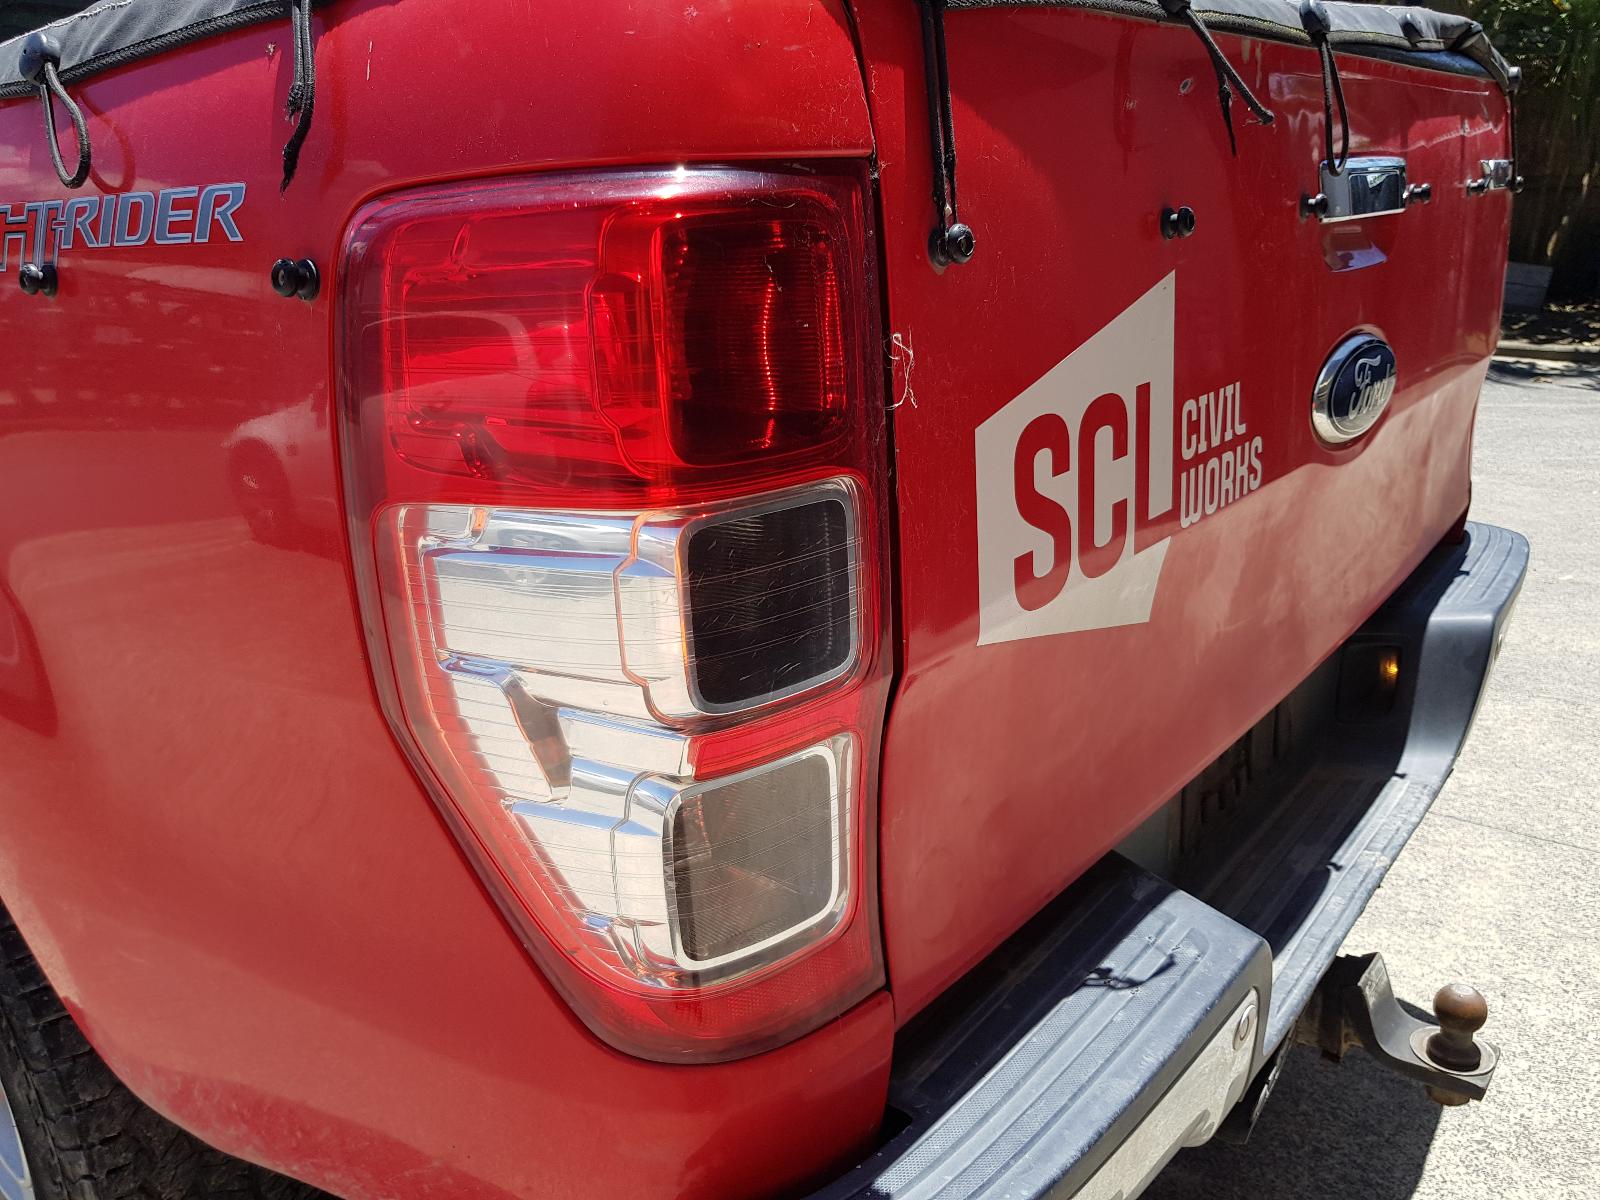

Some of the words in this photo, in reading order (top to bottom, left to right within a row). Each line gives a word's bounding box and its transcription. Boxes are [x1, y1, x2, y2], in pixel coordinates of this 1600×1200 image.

[1181, 382, 1247, 460] CIVIL
[1347, 354, 1392, 420] Ford
[1014, 381, 1172, 612] SCL
[1180, 436, 1263, 529] WORKS
